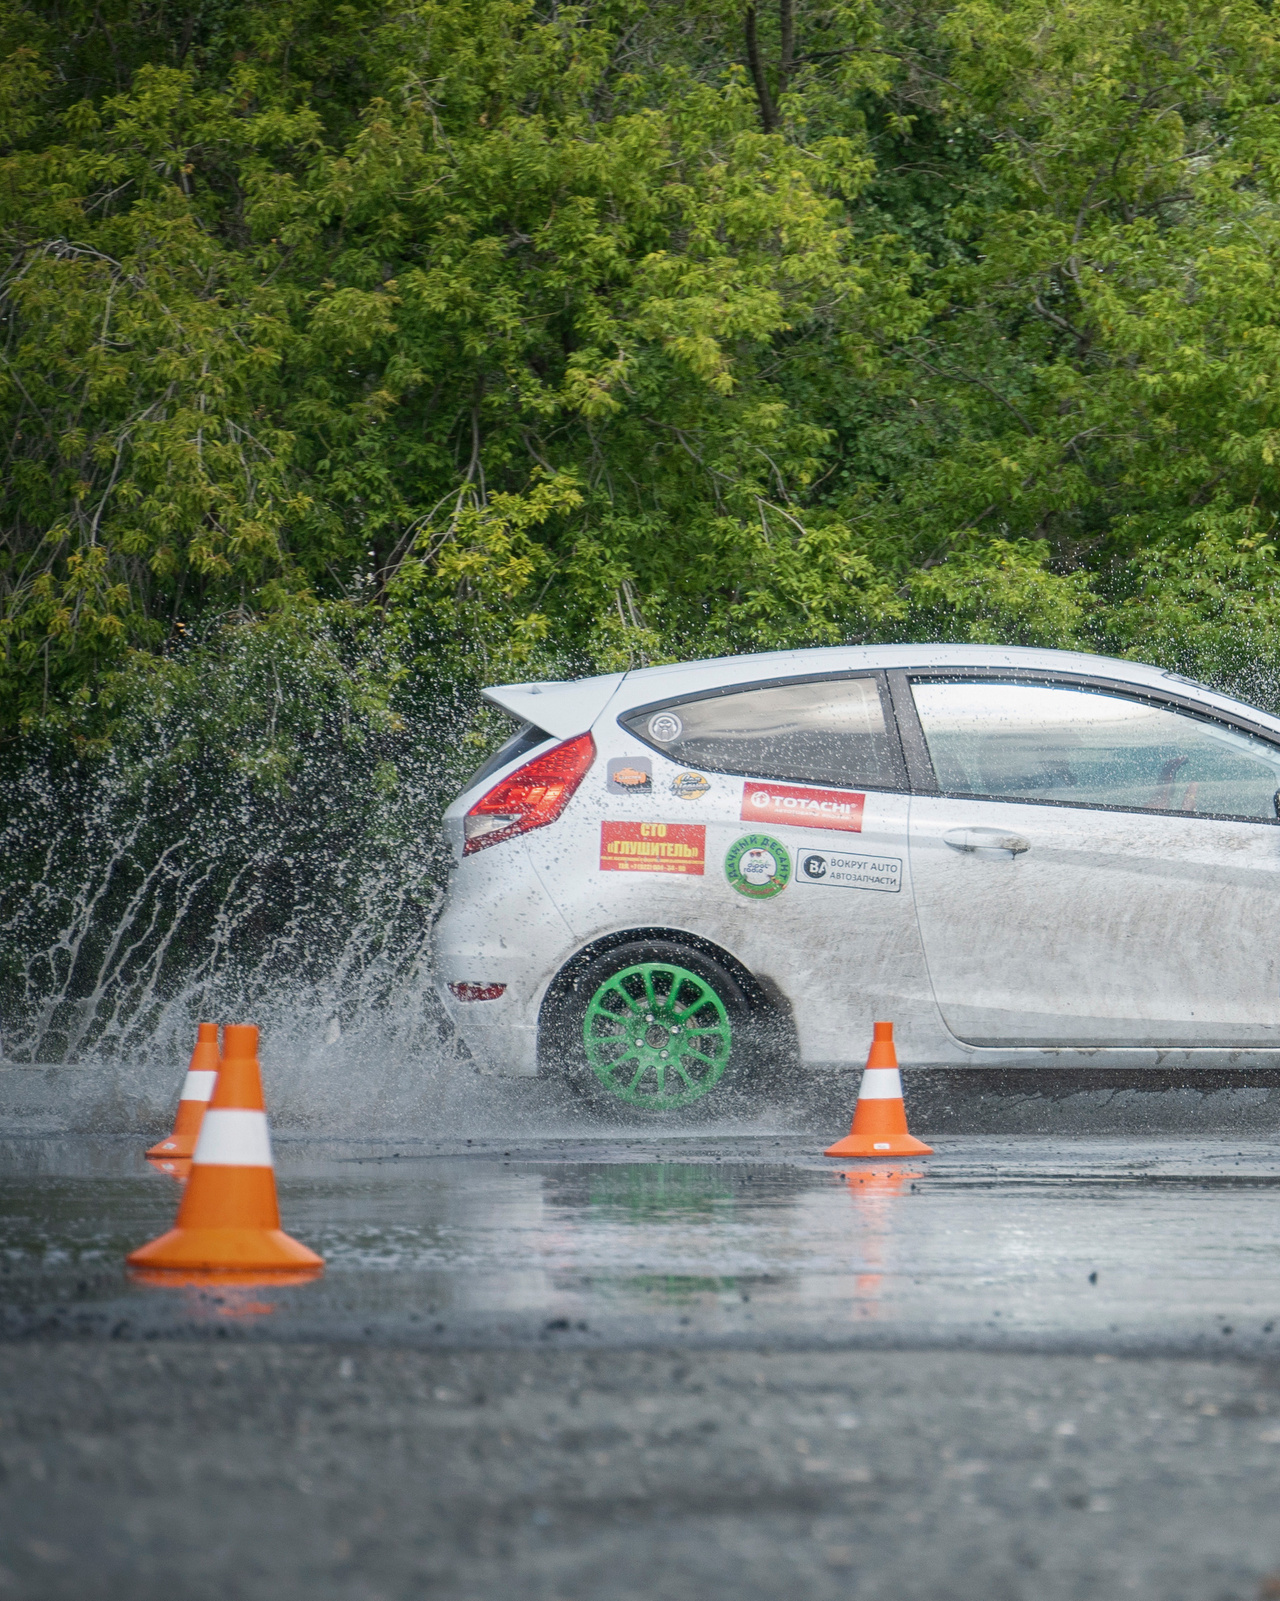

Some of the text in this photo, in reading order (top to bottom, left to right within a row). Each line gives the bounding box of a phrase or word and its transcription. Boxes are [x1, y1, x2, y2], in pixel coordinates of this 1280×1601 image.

[771, 795, 851, 814] TOTACHI
[640, 822, 667, 838] СТО
[727, 834, 789, 881] ДАЧНЫЙ ДЕСАНТ
[830, 858, 898, 873] ВОКРУГ AUTO
[829, 872, 897, 886] АВТОЗАПЧАСТИ
